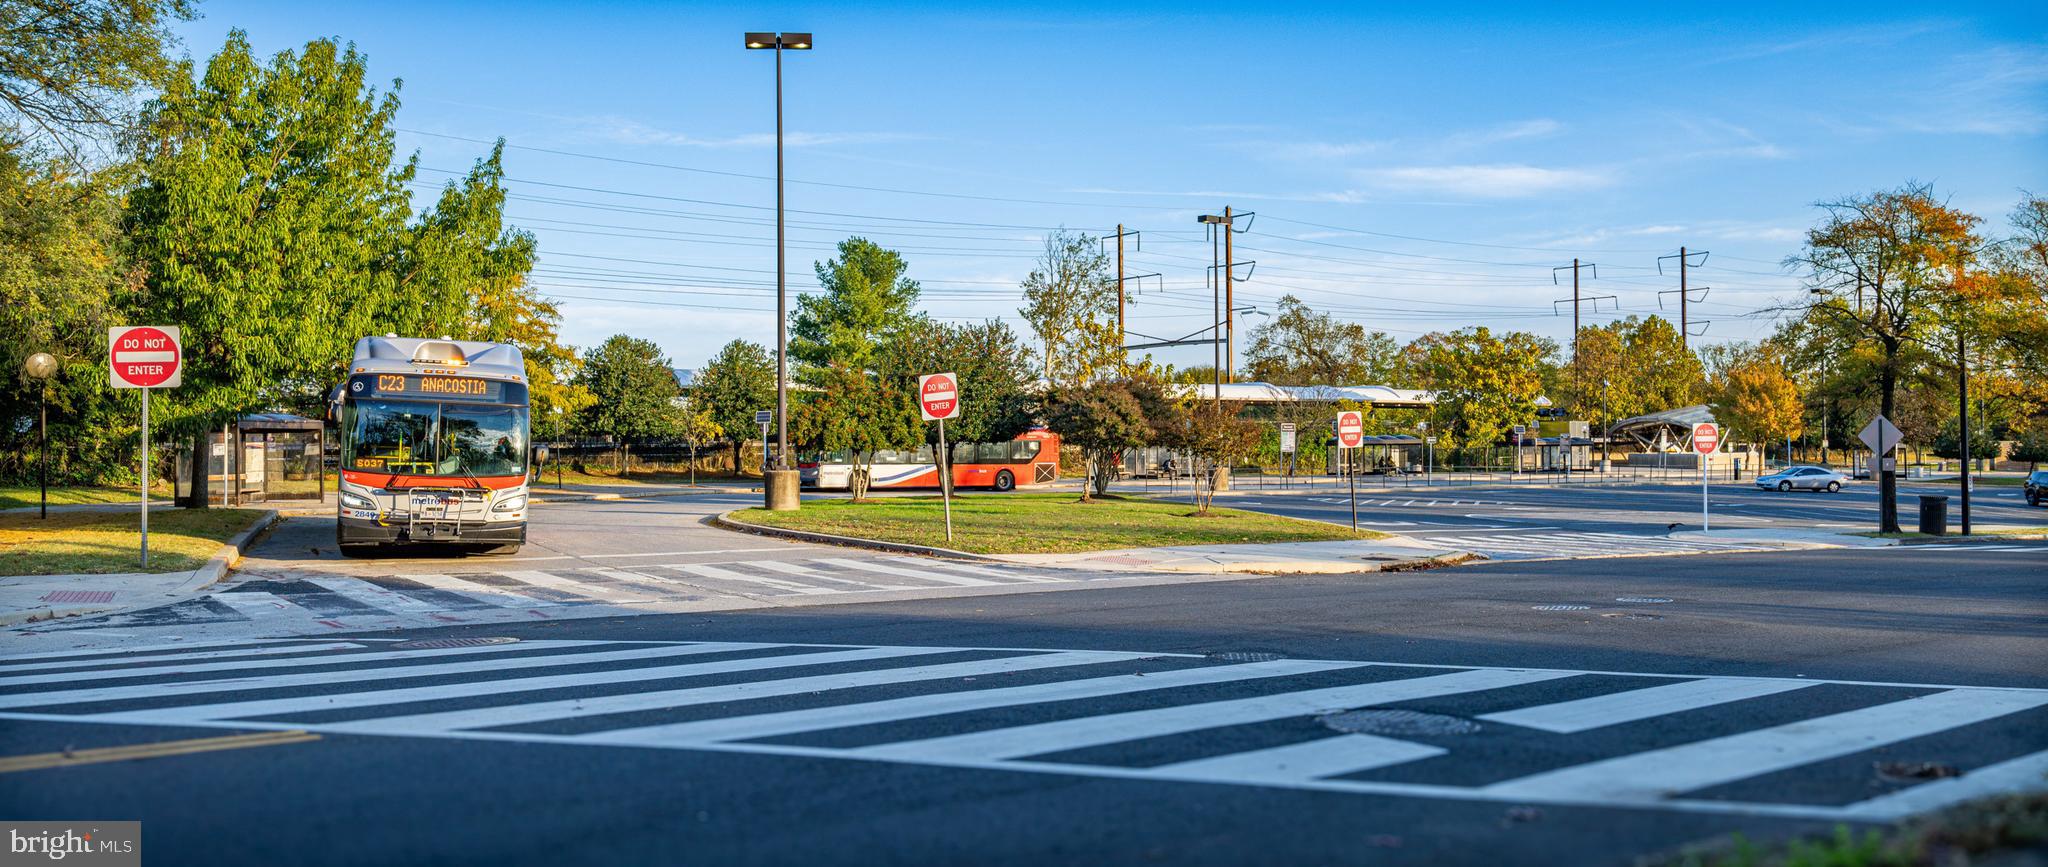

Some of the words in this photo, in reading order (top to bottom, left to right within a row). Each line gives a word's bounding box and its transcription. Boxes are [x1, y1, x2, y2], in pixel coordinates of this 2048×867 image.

[124, 339, 139, 349] DO
[144, 338, 166, 349] NOT
[128, 365, 163, 375] ENTER
[378, 375, 405, 391] C23
[421, 377, 487, 394] ANACOSTIA
[927, 383, 936, 392] DO
[938, 382, 950, 390] NOT
[930, 401, 950, 411] ENTER
[411, 497, 460, 506] metrobus
